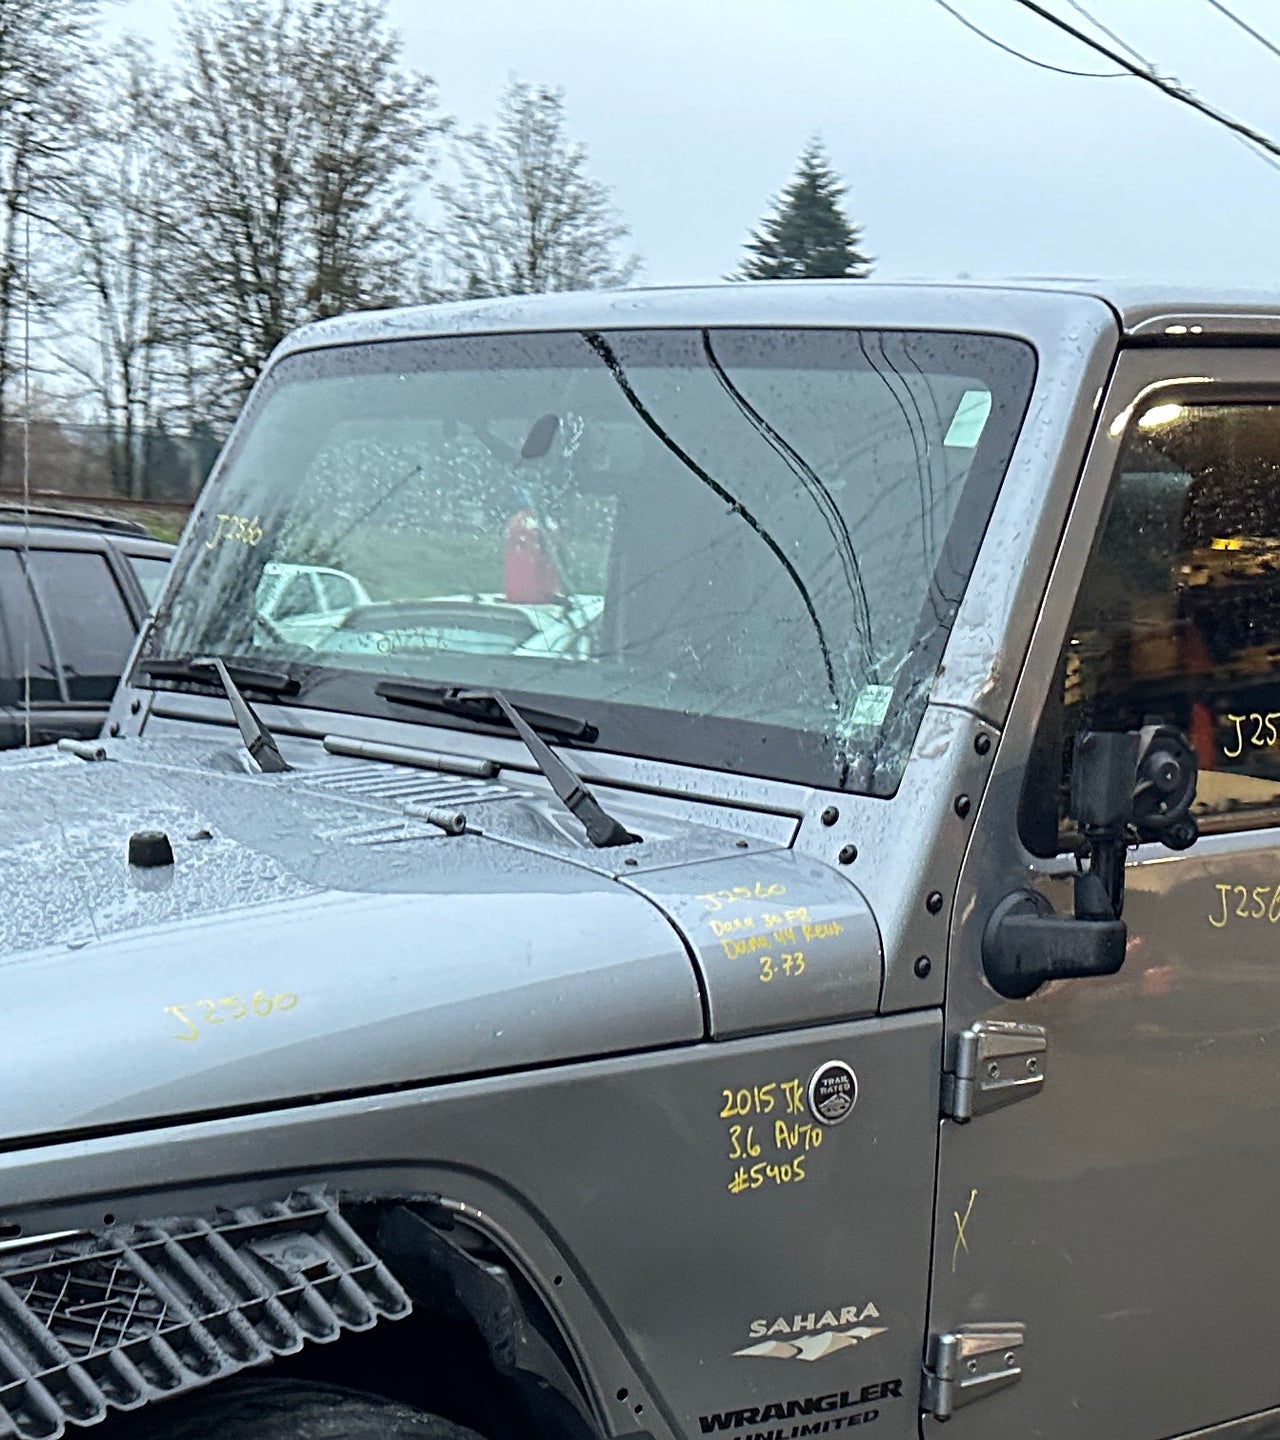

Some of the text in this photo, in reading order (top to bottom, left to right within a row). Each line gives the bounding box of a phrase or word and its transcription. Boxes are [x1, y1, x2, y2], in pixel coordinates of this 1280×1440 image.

[759, 952, 805, 983] 3.73
[163, 988, 299, 1041] J2560
[819, 1083, 851, 1096] RATED
[821, 1075, 849, 1087] TRAIL
[720, 1082, 777, 1118] 2015
[729, 1125, 761, 1159] 3.6
[728, 1155, 806, 1194] #5405
[749, 1301, 880, 1338] SAHARA
[699, 1378, 903, 1434] WRANGLER
